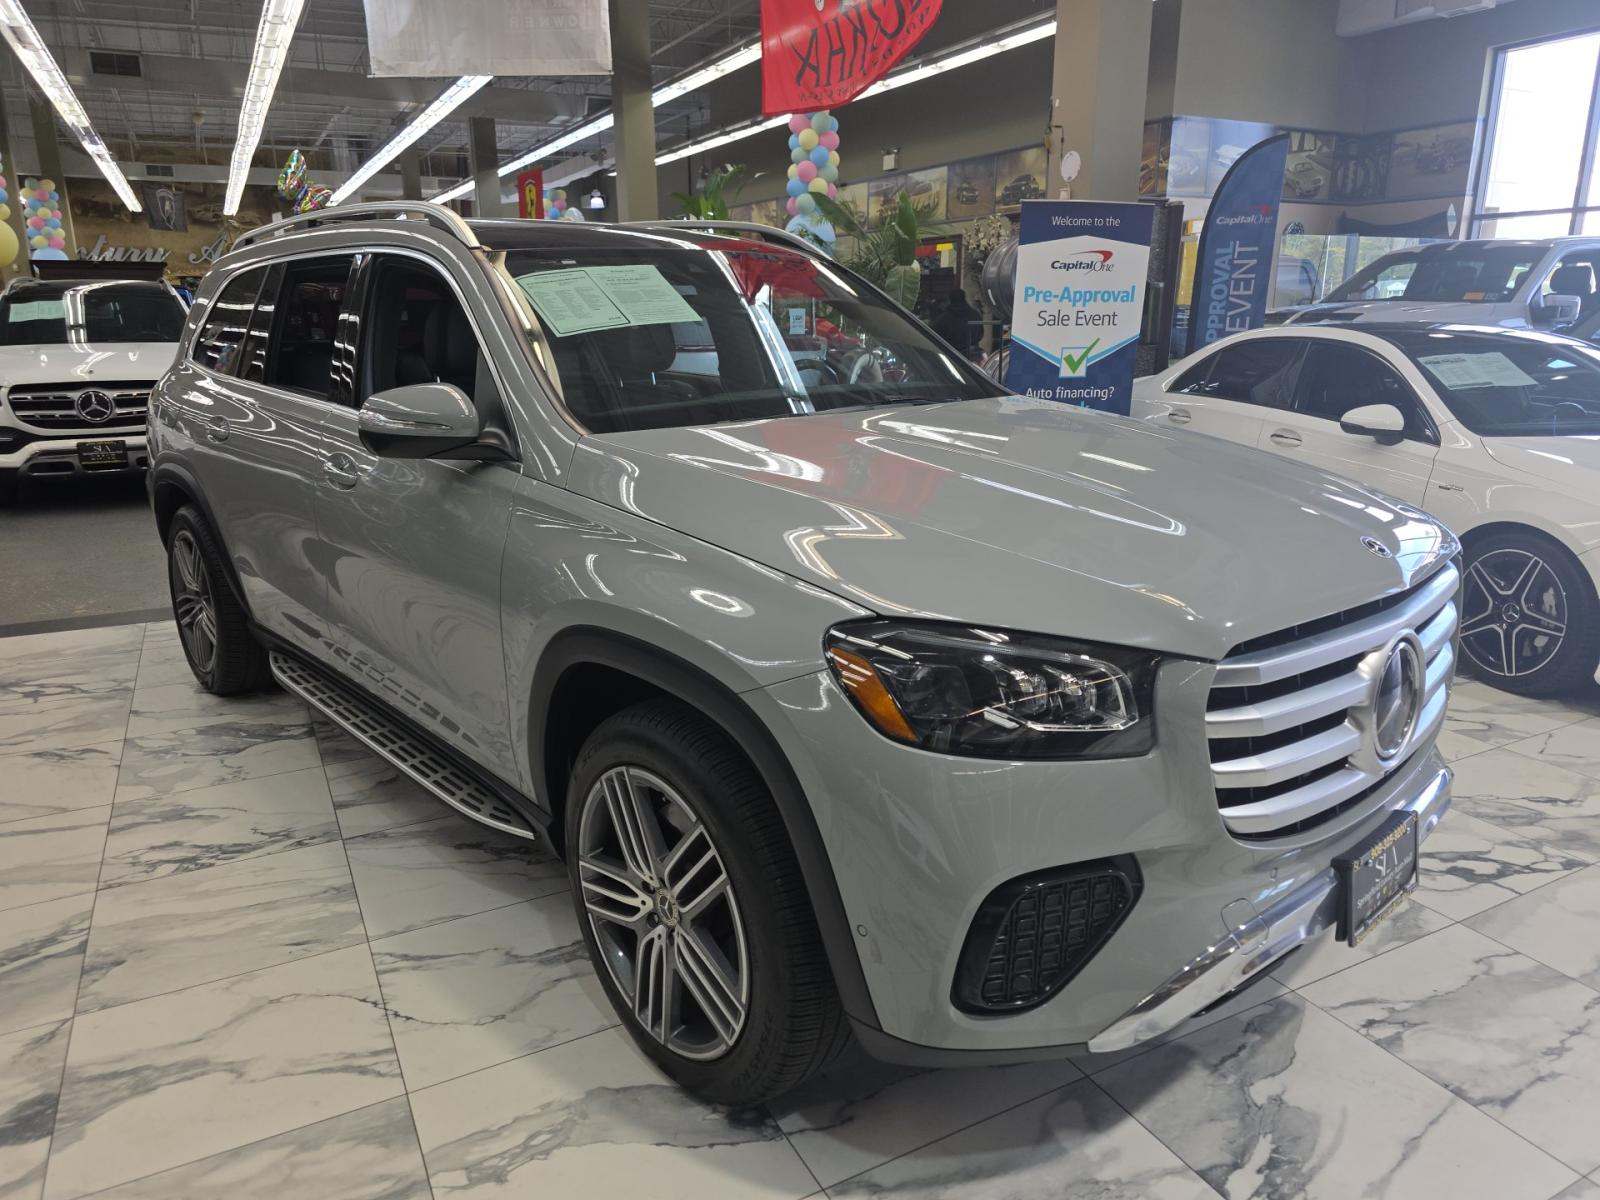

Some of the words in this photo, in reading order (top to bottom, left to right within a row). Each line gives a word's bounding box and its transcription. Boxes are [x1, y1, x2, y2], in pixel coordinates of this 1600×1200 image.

[1051, 216, 1092, 227] Welcome
[1094, 217, 1104, 227] to
[1106, 216, 1121, 227] the
[1226, 241, 1259, 332] EVENT
[1023, 285, 1136, 307] Pre-Approval
[1037, 309, 1070, 327] Sale
[1075, 310, 1118, 327] Event
[1025, 387, 1052, 400] Auto
[1056, 386, 1115, 401] financing?
